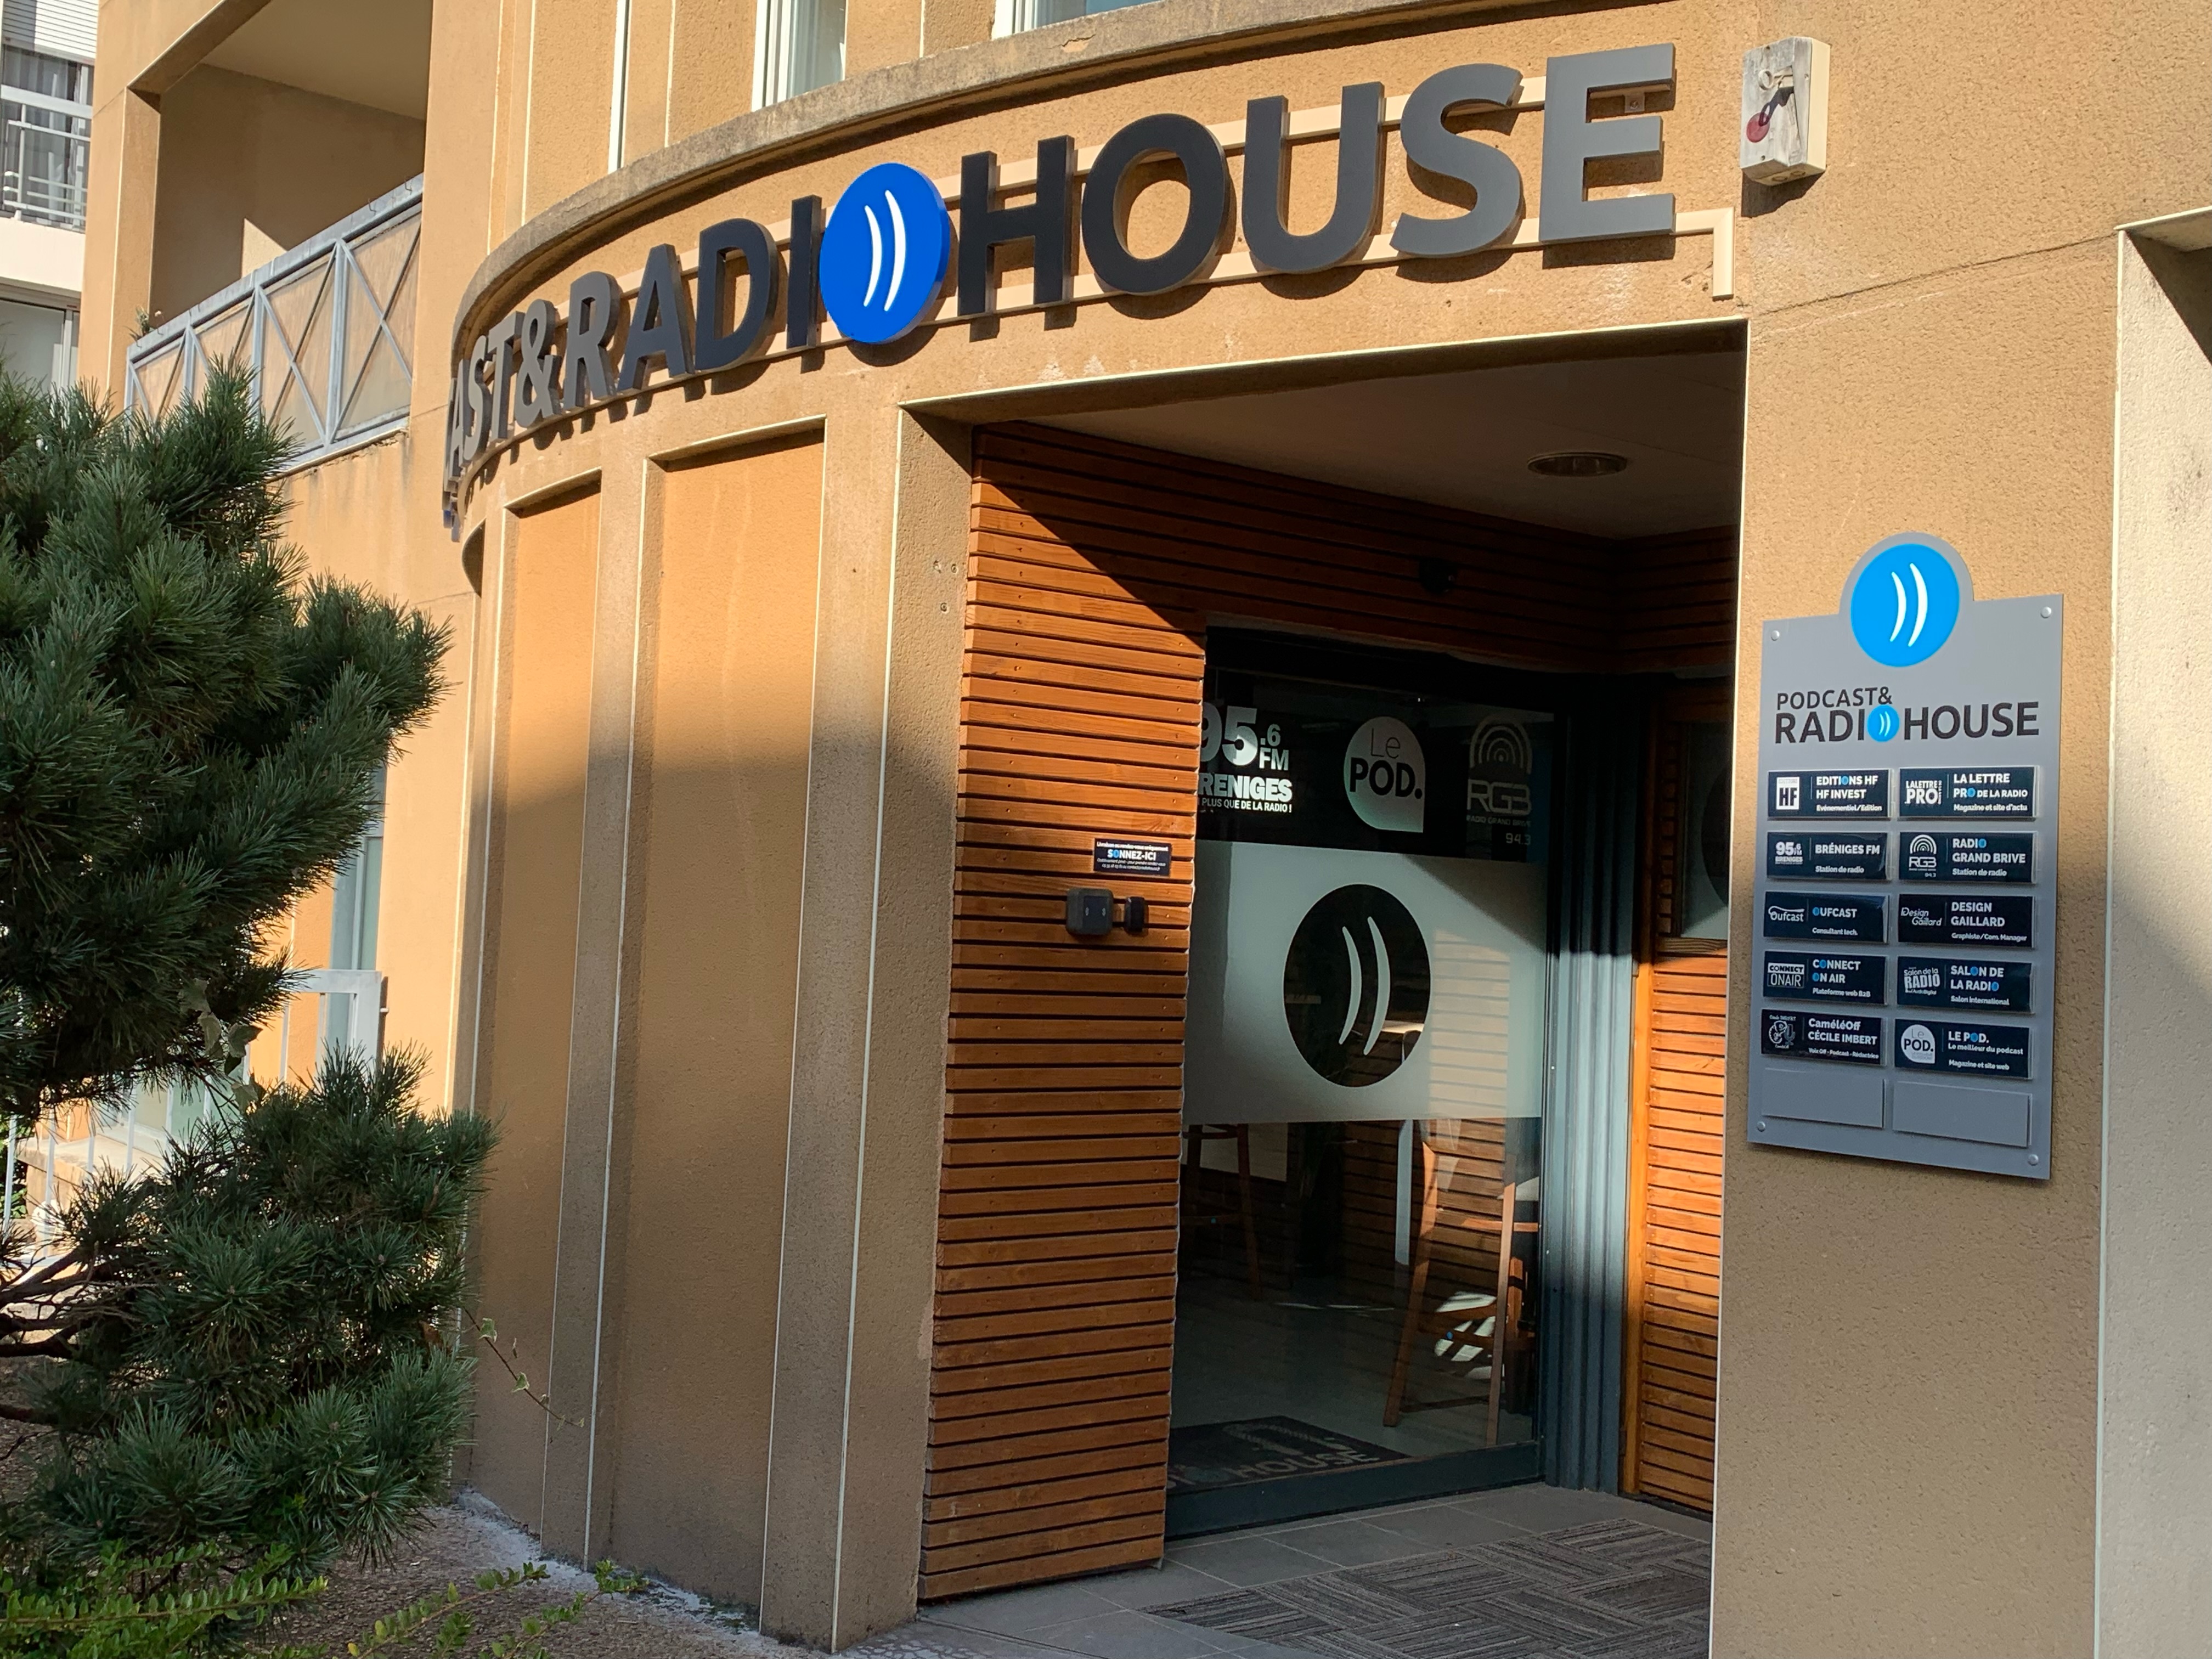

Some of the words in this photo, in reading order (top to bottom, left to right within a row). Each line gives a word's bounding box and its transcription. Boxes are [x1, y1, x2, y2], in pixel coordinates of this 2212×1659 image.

[958, 43, 1676, 317] HOUSE
[1777, 687, 1893, 710] PODCAST&
[1904, 702, 2039, 741] HOUSE
[1371, 727, 1401, 759] Le
[1259, 747, 1288, 771] FM
[1349, 758, 1423, 799] POD.
[1816, 776, 1862, 786] EDITIONS
[1865, 775, 1878, 785] HF
[1954, 774, 1970, 783] LA
[1970, 774, 2010, 783] LETTRE
[1198, 773, 1293, 802] RENIGES
[1954, 788, 1976, 798] PRO
[1466, 779, 1532, 816] RGB
[1779, 787, 1797, 806] HF
[1816, 790, 1829, 799] HF
[1831, 789, 1867, 799] INVEST
[1202, 798, 1222, 807] PLUS
[1224, 799, 1240, 809] QUE
[1241, 801, 1251, 809] DE
[1253, 802, 1262, 811] LA
[1265, 803, 1288, 812] RADIO
[1289, 804, 1292, 813] !
[1954, 804, 1984, 812] Magazine
[1488, 816, 1511, 826] GRAND
[1506, 833, 1531, 845] 94.3
[1953, 838, 1987, 848] RADIO
[1815, 843, 1864, 854] BRÉNIGES
[1866, 845, 1880, 854] FM
[1909, 856, 1937, 867] RGB
[1952, 853, 1991, 863] GRAND
[1993, 853, 2025, 863] BRIVE
[1813, 907, 1857, 918] OUFCAST
[1951, 902, 1992, 912] DESIGN
[1769, 909, 1804, 922] Oufcast
[1900, 907, 1928, 919] Design
[1951, 916, 2005, 927] GAILLARD
[1769, 965, 1804, 973] CONNECT
[1813, 960, 1861, 970] CONNECT
[1904, 968, 1922, 976] Salon
[1951, 966, 1987, 976] SALON
[1989, 967, 2004, 977] DE
[1812, 973, 1827, 982] ON
[1829, 974, 1846, 983] AIR
[1904, 974, 1940, 989] RADIO
[1951, 979, 1963, 989] LA
[1966, 980, 1999, 991] RADIO
[1813, 988, 1844, 996] Plateforme
[1808, 1018, 1861, 1030] CaméléOff
[1808, 1030, 1839, 1042] CÉCILE
[1842, 1034, 1877, 1045] IMBERT
[1948, 1031, 1961, 1041] LE
[1904, 1039, 1934, 1052] POD.
[1986, 1044, 1995, 1052] du
[1996, 1046, 2023, 1055] podcast
[1949, 1059, 1977, 1068] Magazine
